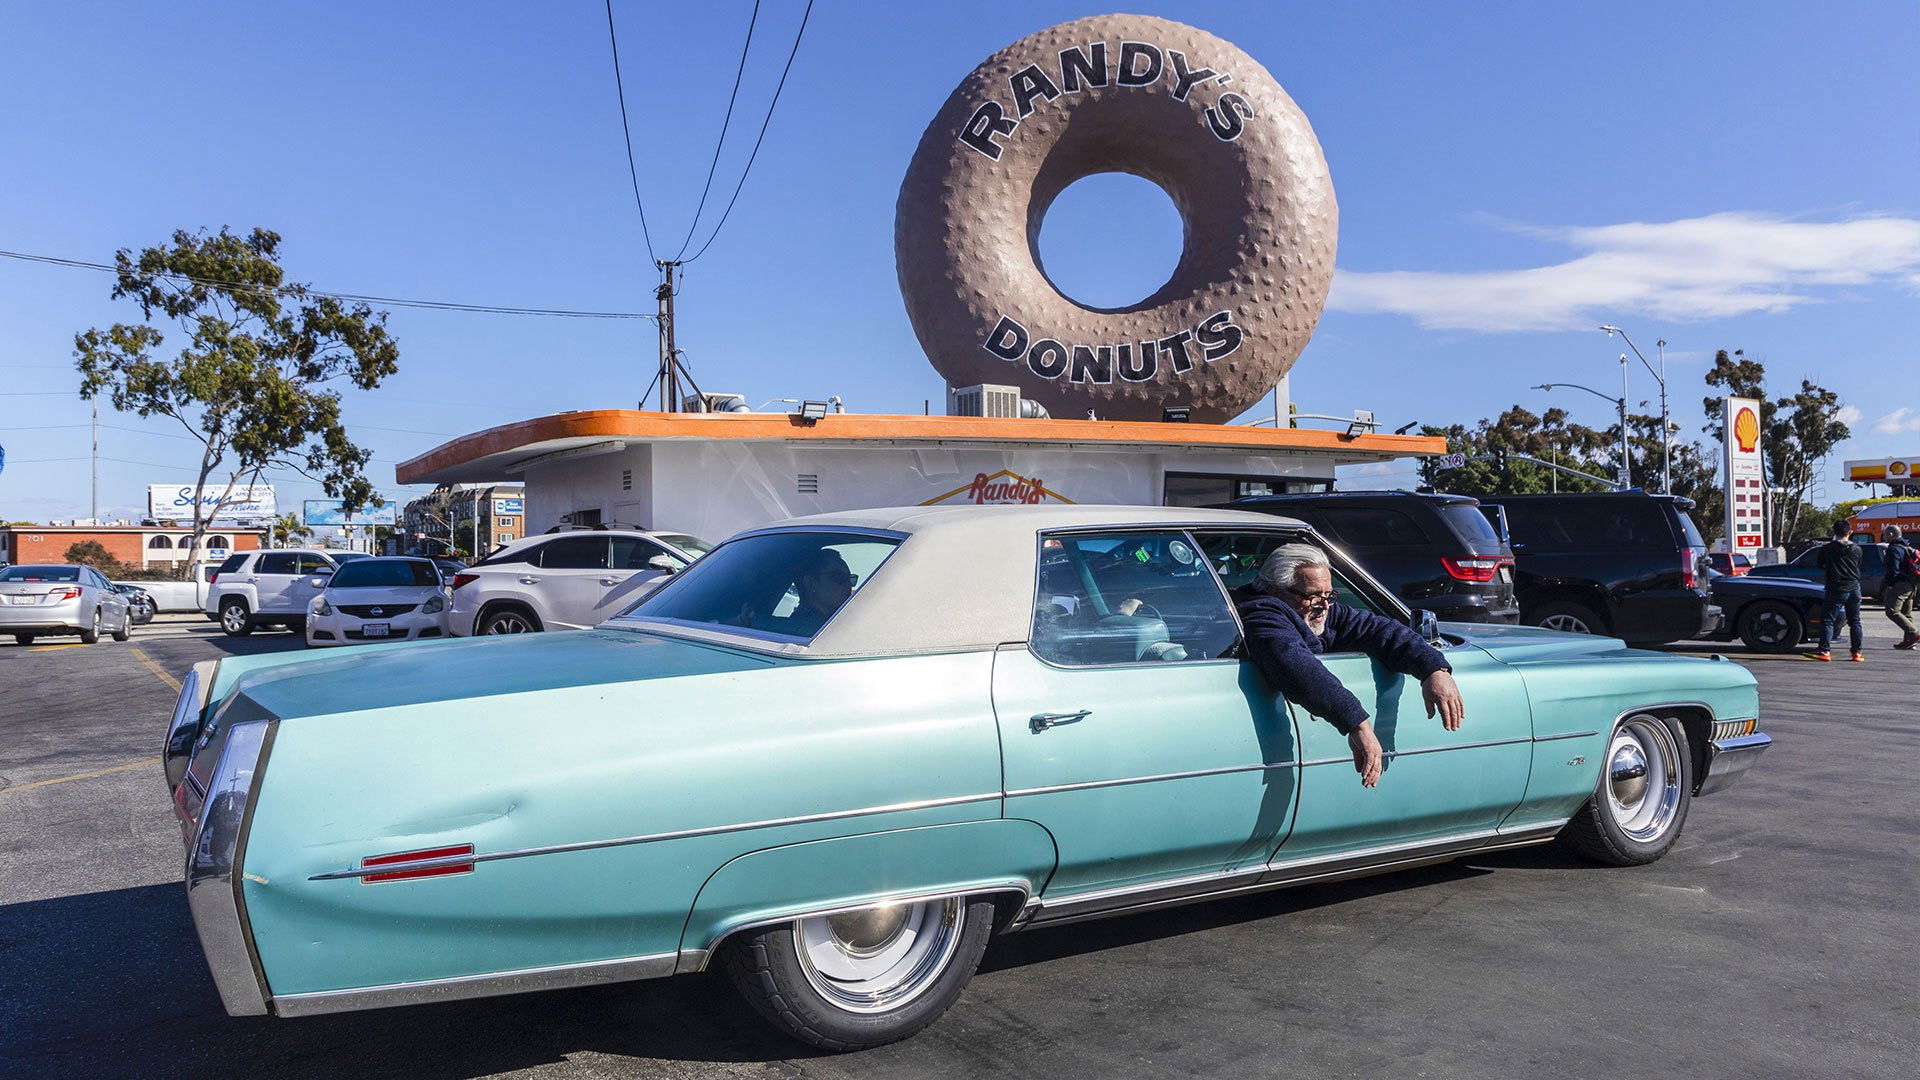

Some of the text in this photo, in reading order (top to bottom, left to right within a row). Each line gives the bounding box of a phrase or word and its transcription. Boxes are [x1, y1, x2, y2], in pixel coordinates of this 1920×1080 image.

[958, 41, 1254, 162] RANDY'S
[983, 310, 1244, 384] DONUTS
[968, 473, 1046, 504] Randy's
